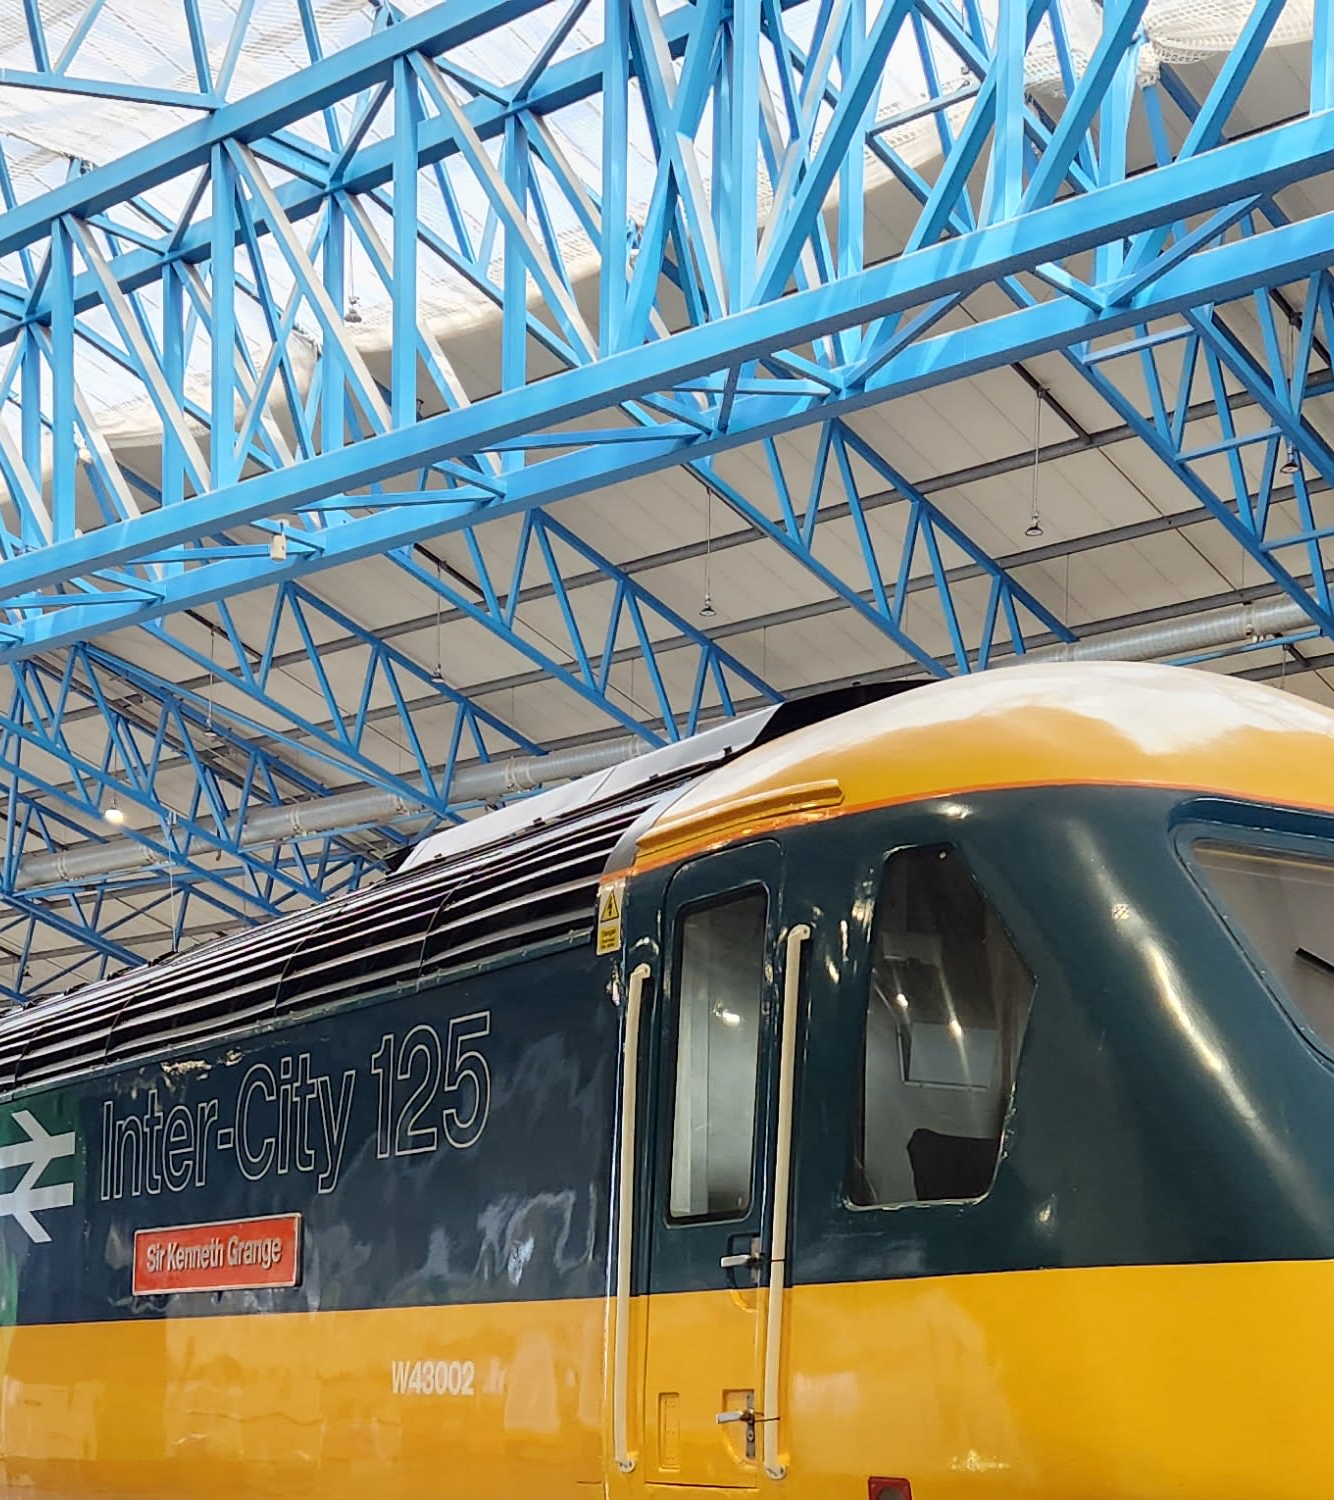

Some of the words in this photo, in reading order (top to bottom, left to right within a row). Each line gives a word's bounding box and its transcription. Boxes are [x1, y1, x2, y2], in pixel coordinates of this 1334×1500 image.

[100, 1052, 357, 1201] Inter-City
[370, 1010, 493, 1160] 125
[146, 1243, 166, 1273] Sir
[167, 1237, 225, 1271] Kenneth
[226, 1235, 283, 1269] Grange
[391, 1359, 475, 1396] W43002
